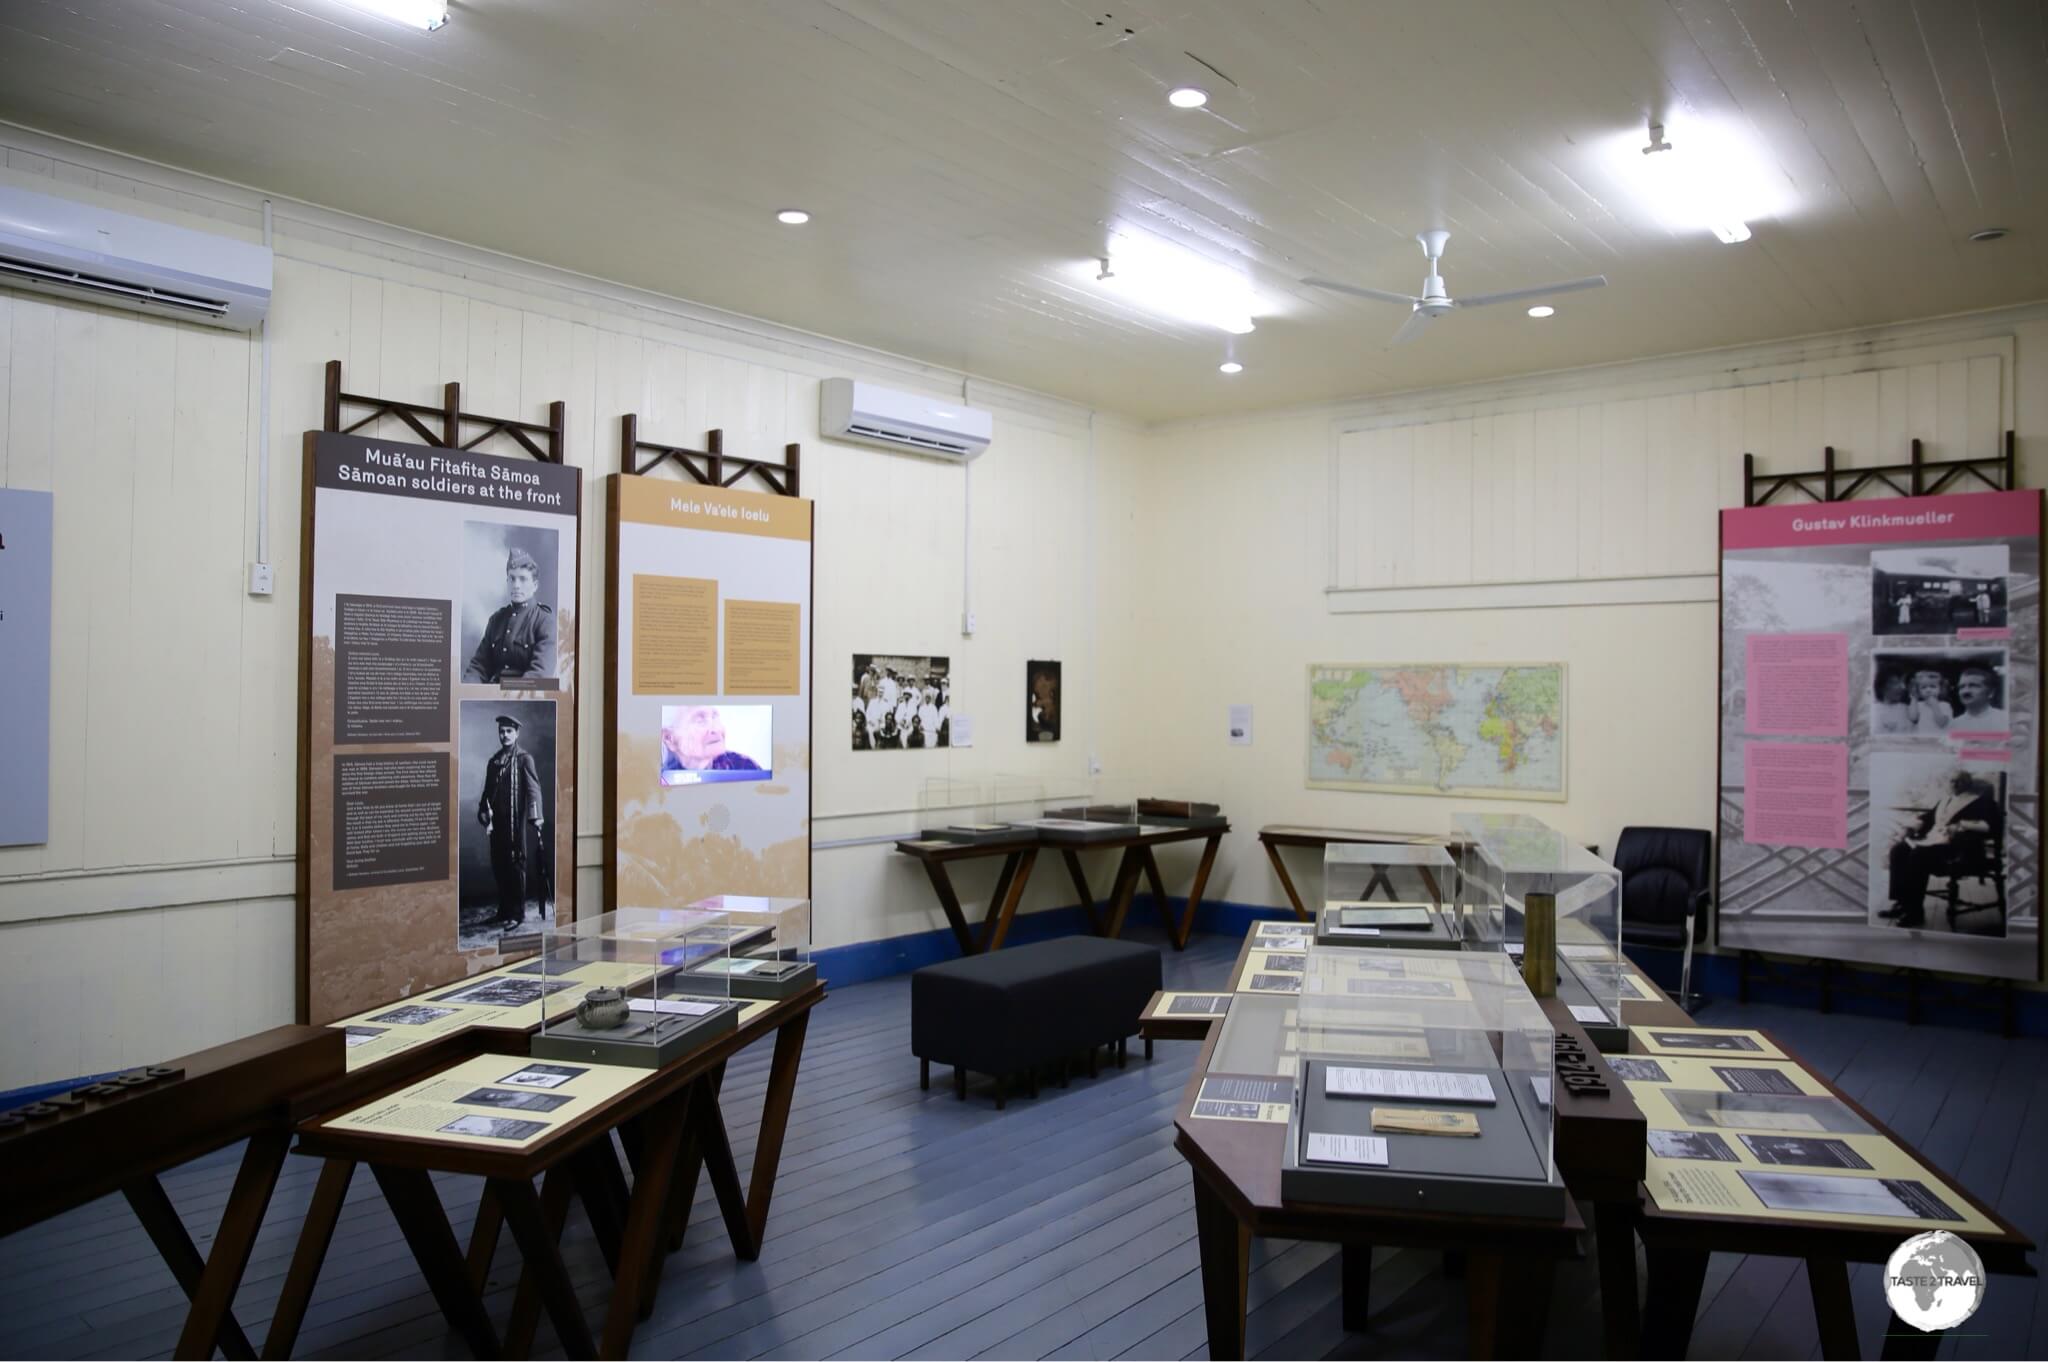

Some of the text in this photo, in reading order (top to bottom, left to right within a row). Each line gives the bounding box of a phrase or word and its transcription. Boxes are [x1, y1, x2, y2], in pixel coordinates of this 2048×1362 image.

[430, 457, 487, 479] Fitafita
[490, 465, 541, 486] Sāmoa
[338, 464, 561, 507] Sāmoan soldiers at the front
[671, 498, 701, 514] Mele
[1792, 511, 1955, 532] Gustav Klinkmueller
